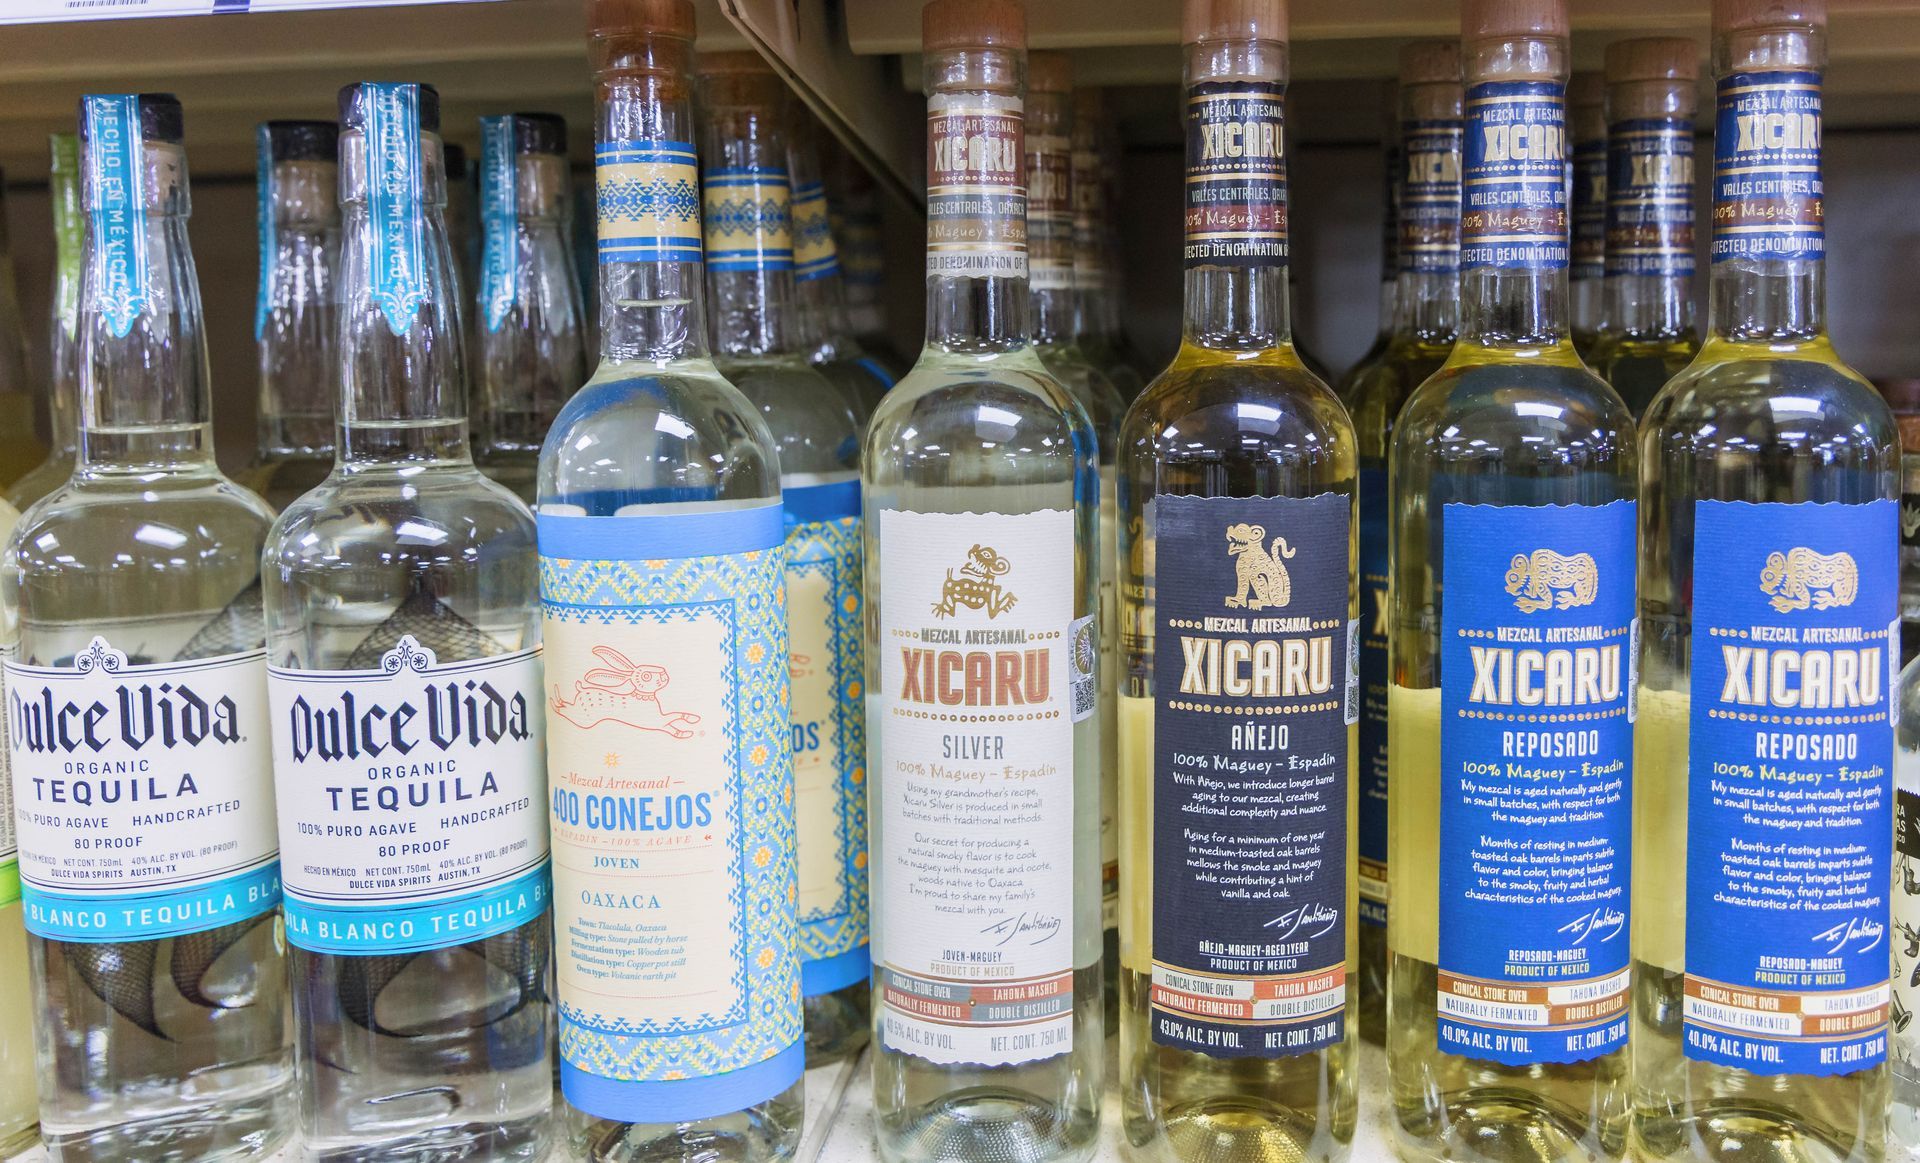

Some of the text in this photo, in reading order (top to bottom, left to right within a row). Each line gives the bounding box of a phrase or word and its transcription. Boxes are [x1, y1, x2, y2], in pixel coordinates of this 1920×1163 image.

[103, 101, 120, 168] HECHO
[108, 177, 121, 201] EN
[1192, 188, 1217, 203] VALLES
[1471, 192, 1498, 206] VALLES
[1206, 210, 1260, 227] Maguey
[1488, 213, 1542, 228] Maguey
[1741, 204, 1799, 219] Maguey
[1213, 243, 1283, 257] DENOMINATION
[940, 257, 1023, 270] DENOMINATION OF
[1204, 617, 1312, 633] MEZCAL ARTESANAL
[1497, 626, 1604, 642] MEZCAL ARTESANAL
[921, 628, 1027, 645] MEZCAL ARTESANAL
[1751, 626, 1863, 644] MEZCAL ARTESANAL
[10, 686, 111, 753] Dulce
[290, 690, 420, 764] Dulce
[1231, 721, 1289, 750] AÑEJO
[1503, 730, 1598, 758] REPOSADO
[943, 734, 1004, 760] SILVER
[1756, 732, 1857, 761] REPOSADO
[65, 759, 149, 775] ORGANIC
[368, 760, 456, 780] ORGANIC
[897, 761, 925, 776] 100%
[930, 764, 985, 783] Maguey
[1173, 753, 1208, 769] 100%
[1213, 755, 1272, 774] Maguey
[1463, 761, 1501, 777] 100%
[1506, 763, 1565, 782] Maguey
[568, 772, 670, 790] Mezcal Artesanal
[1173, 771, 1195, 786] With
[1243, 779, 1287, 790] introduce
[1289, 778, 1314, 790] longer
[1315, 772, 1335, 785] barrel
[1714, 762, 1754, 778] 100%
[1760, 765, 1822, 785] Maguey
[33, 773, 198, 806] TEQUILA
[326, 771, 498, 812] TEQUILA
[1192, 791, 1319, 804] aging to our mezcal, creating
[133, 800, 240, 826] HANDCRAFTED
[440, 797, 529, 829] HANDCRAFTED
[553, 788, 712, 831] 400 CONEJOS
[1182, 803, 1227, 816] additional
[1230, 806, 1278, 819] complexity
[1280, 806, 1297, 816] and
[34, 814, 109, 828] PURO AGAVE
[298, 822, 417, 837] 100% PURO AGAVE
[75, 836, 143, 849] 80 PROOF
[1184, 828, 1209, 843] Aging
[1212, 832, 1226, 843] for
[1237, 834, 1278, 844] minimum
[1281, 832, 1291, 843] of
[1293, 834, 1308, 842] one
[1309, 830, 1325, 844] year
[379, 839, 450, 857] 80 PROOF
[1189, 843, 1320, 859] in medium-toasted oak barrels
[440, 858, 455, 869] 40%
[457, 855, 472, 867] ALC.
[475, 853, 483, 863] BY
[484, 849, 498, 861] VOL.
[594, 856, 640, 869] JOVEN
[1187, 858, 1322, 871] mellows the smoke and maguey
[304, 865, 356, 877] HECHO EN MÉXICO
[366, 867, 381, 877] NET
[406, 863, 431, 874] 750mL
[471, 866, 481, 875] TX
[1196, 872, 1217, 883] while
[1220, 874, 1276, 887] contributing
[1286, 873, 1302, 884] hint
[1304, 871, 1315, 881] of
[350, 875, 431, 889] DULCE VIDA SPIRITS
[582, 890, 662, 909] OAXACA
[1221, 888, 1250, 898] vanilla
[1252, 888, 1270, 899] and
[31, 893, 235, 928] BLANCO TEQUILA
[319, 894, 526, 940] BLANCO TEQUILA
[942, 949, 1002, 962] JOVEN-MAGUEY
[1509, 948, 1586, 962] REPOSADO-MAGUEY
[1760, 956, 1842, 970] REPOSADO-MAGUEY
[931, 963, 1015, 976] PRODUCT OF MEXICO
[1211, 959, 1297, 971] PRODUCT OF MEXICO
[1505, 963, 1590, 976] PRODUCT OF MEXICO
[993, 981, 1058, 1000] TAHONA MASHED
[1165, 974, 1234, 996] CONICAL STONE OVEN
[1274, 976, 1333, 997] TAHONA MASHED
[1158, 990, 1243, 1016] NATURALLY FERMENTED
[1270, 993, 1335, 1016] DOUBLE DISTILLED
[1160, 1019, 1243, 1048] 43.0% ALC. BY VOL.
[1265, 1021, 1337, 1049] NET. CONT. 750 ML
[1688, 1029, 1784, 1063] 40.0% ALC. BY VOL.
